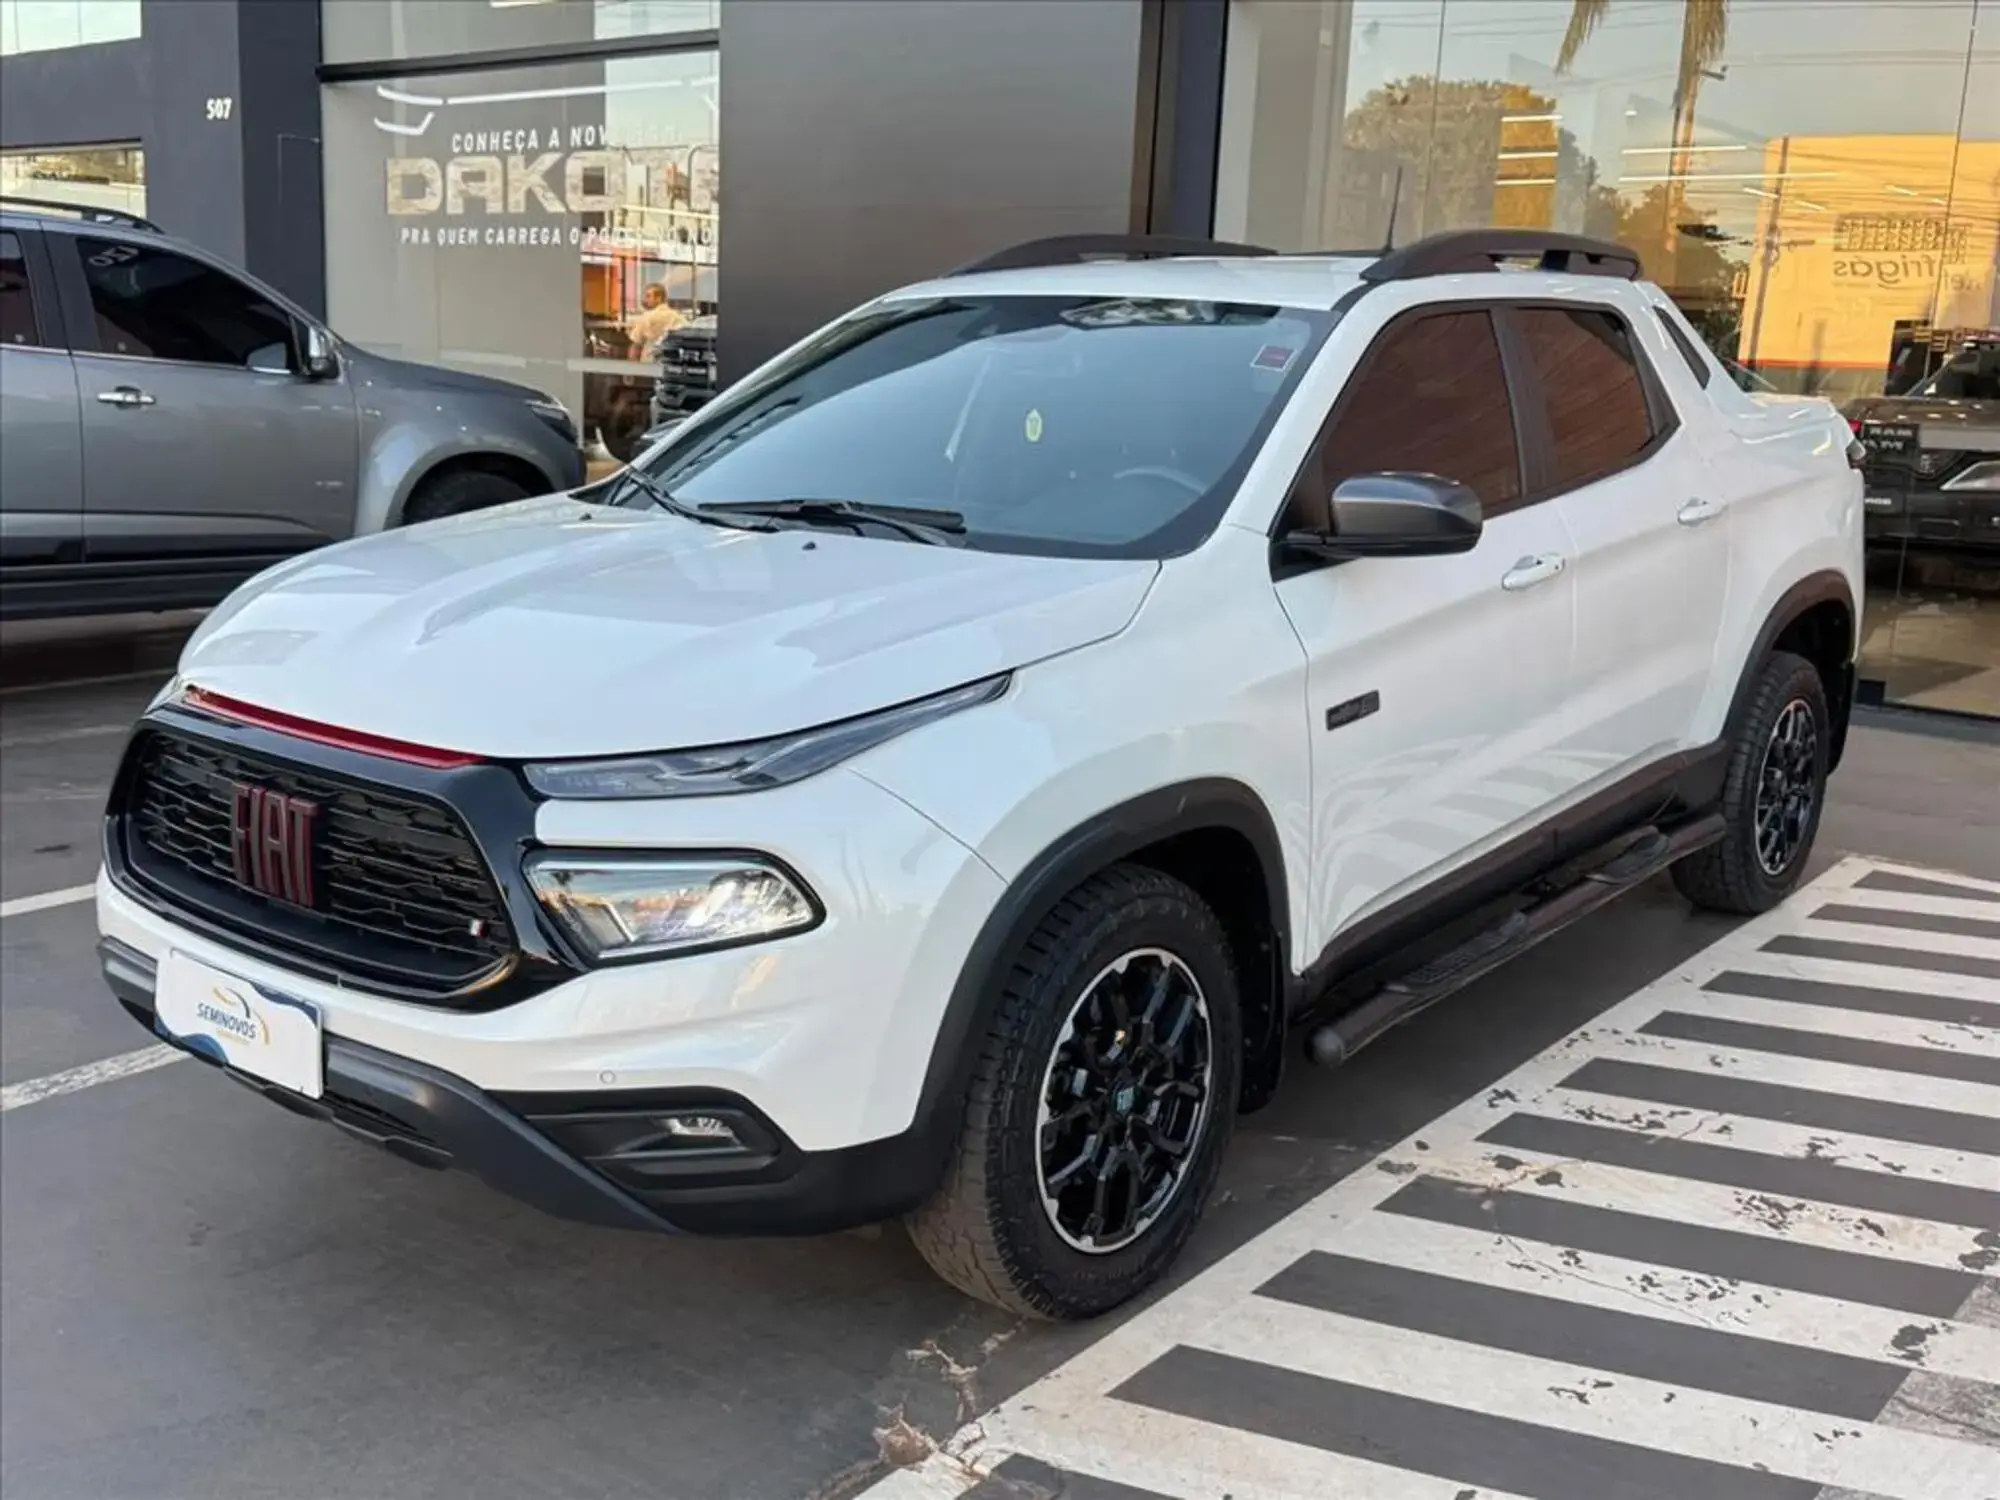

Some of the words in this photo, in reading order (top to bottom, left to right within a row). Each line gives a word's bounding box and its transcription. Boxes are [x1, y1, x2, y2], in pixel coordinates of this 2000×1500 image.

[206, 97, 232, 120] 507
[451, 127, 539, 157] CONHEÇA
[548, 126, 560, 149] A
[400, 227, 431, 245] PRA
[436, 226, 479, 247] QUEM
[485, 226, 561, 246] CARREGA
[569, 226, 580, 245] O
[229, 781, 318, 909] FIAT
[197, 1001, 257, 1039] SEMINOVOS
